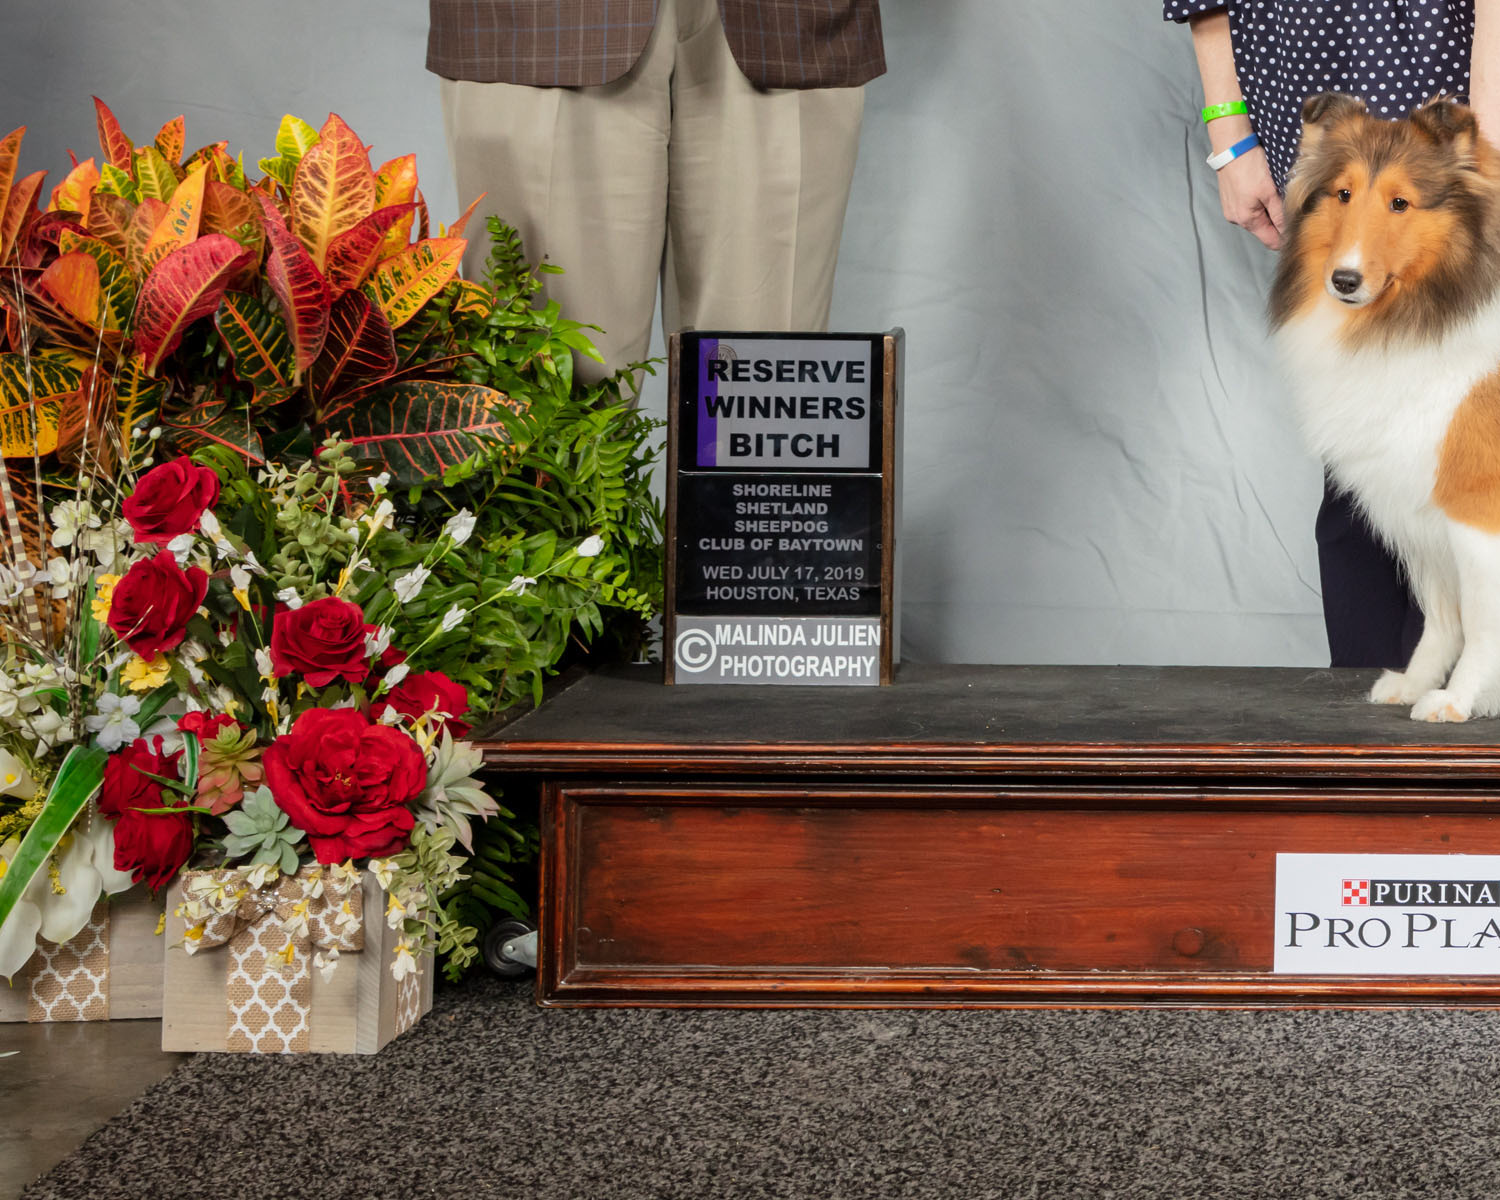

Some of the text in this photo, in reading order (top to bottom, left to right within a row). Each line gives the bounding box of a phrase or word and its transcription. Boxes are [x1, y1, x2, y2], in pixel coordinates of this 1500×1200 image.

[707, 359, 865, 383] RESERVE
[705, 396, 866, 420] WINNERS
[730, 433, 840, 458] BITCH
[732, 484, 832, 497] SHORELINE
[735, 502, 828, 515] SHETLAND
[734, 520, 829, 533] SHEEPDOG
[699, 538, 863, 551] CLUB OF BAYTOWN
[702, 566, 865, 582] WED JULY 17, 2019
[706, 586, 861, 602] HOUSTON, TEXAS
[715, 624, 880, 646] MALINDA JULIEN
[719, 655, 876, 677] PHOTOGRAPHY
[1374, 883, 1496, 905] PURINA
[1284, 912, 1392, 949] PRO
